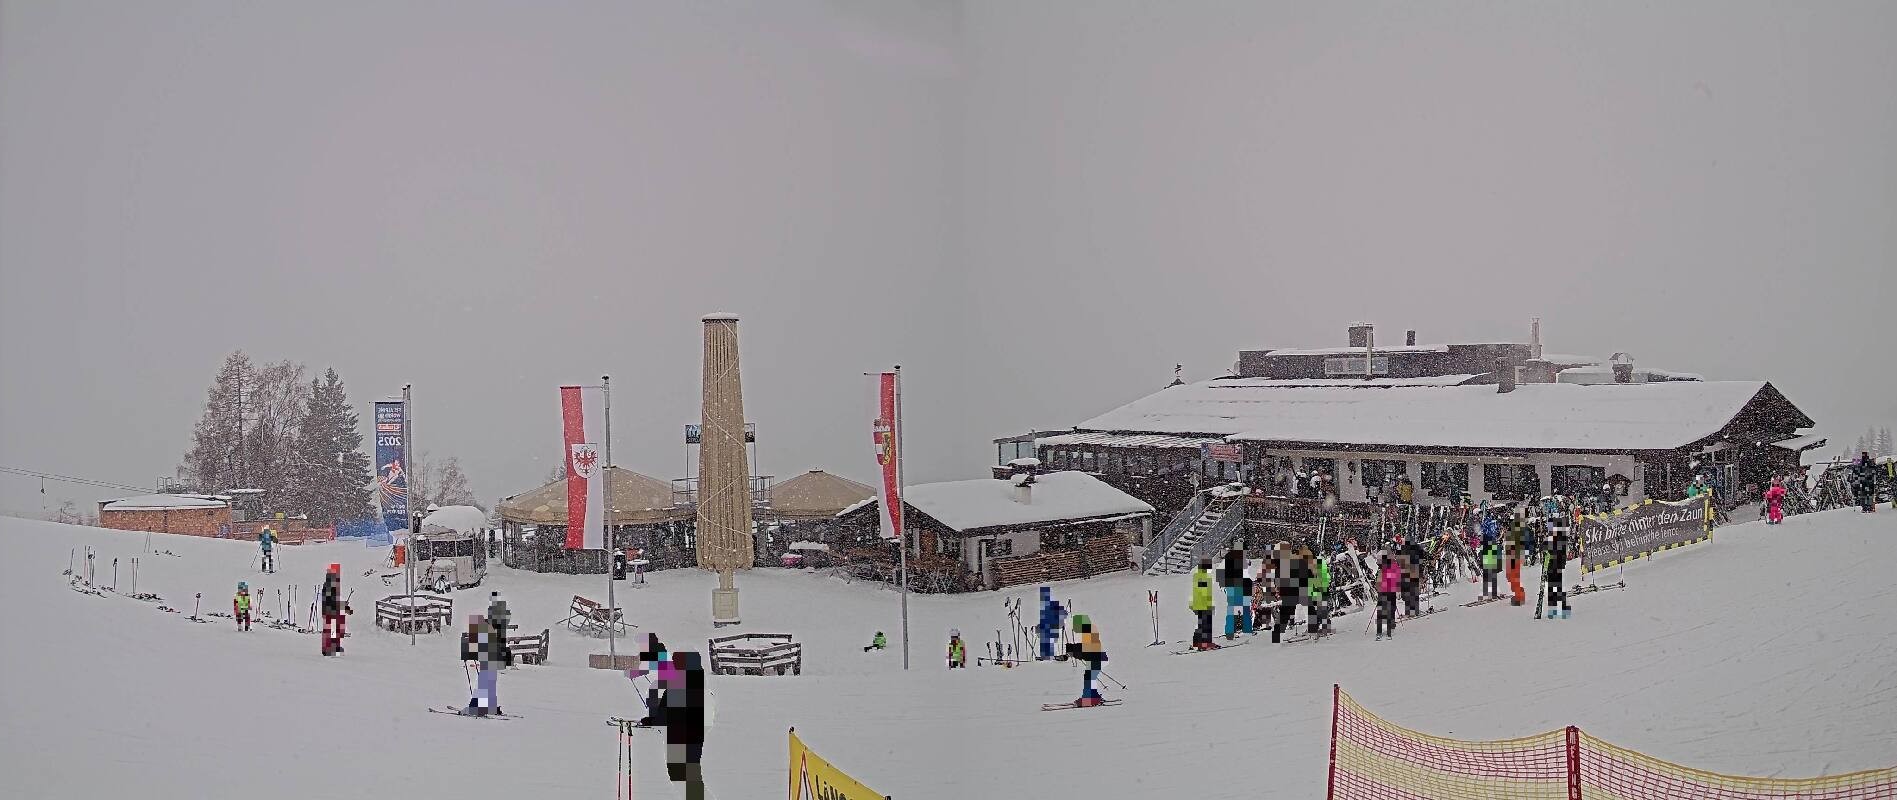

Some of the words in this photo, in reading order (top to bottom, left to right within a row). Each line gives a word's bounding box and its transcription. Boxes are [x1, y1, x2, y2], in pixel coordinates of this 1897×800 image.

[1585, 525, 1603, 544] Ski
[1656, 510, 1678, 526] den
[1679, 507, 1703, 523] Zaun
